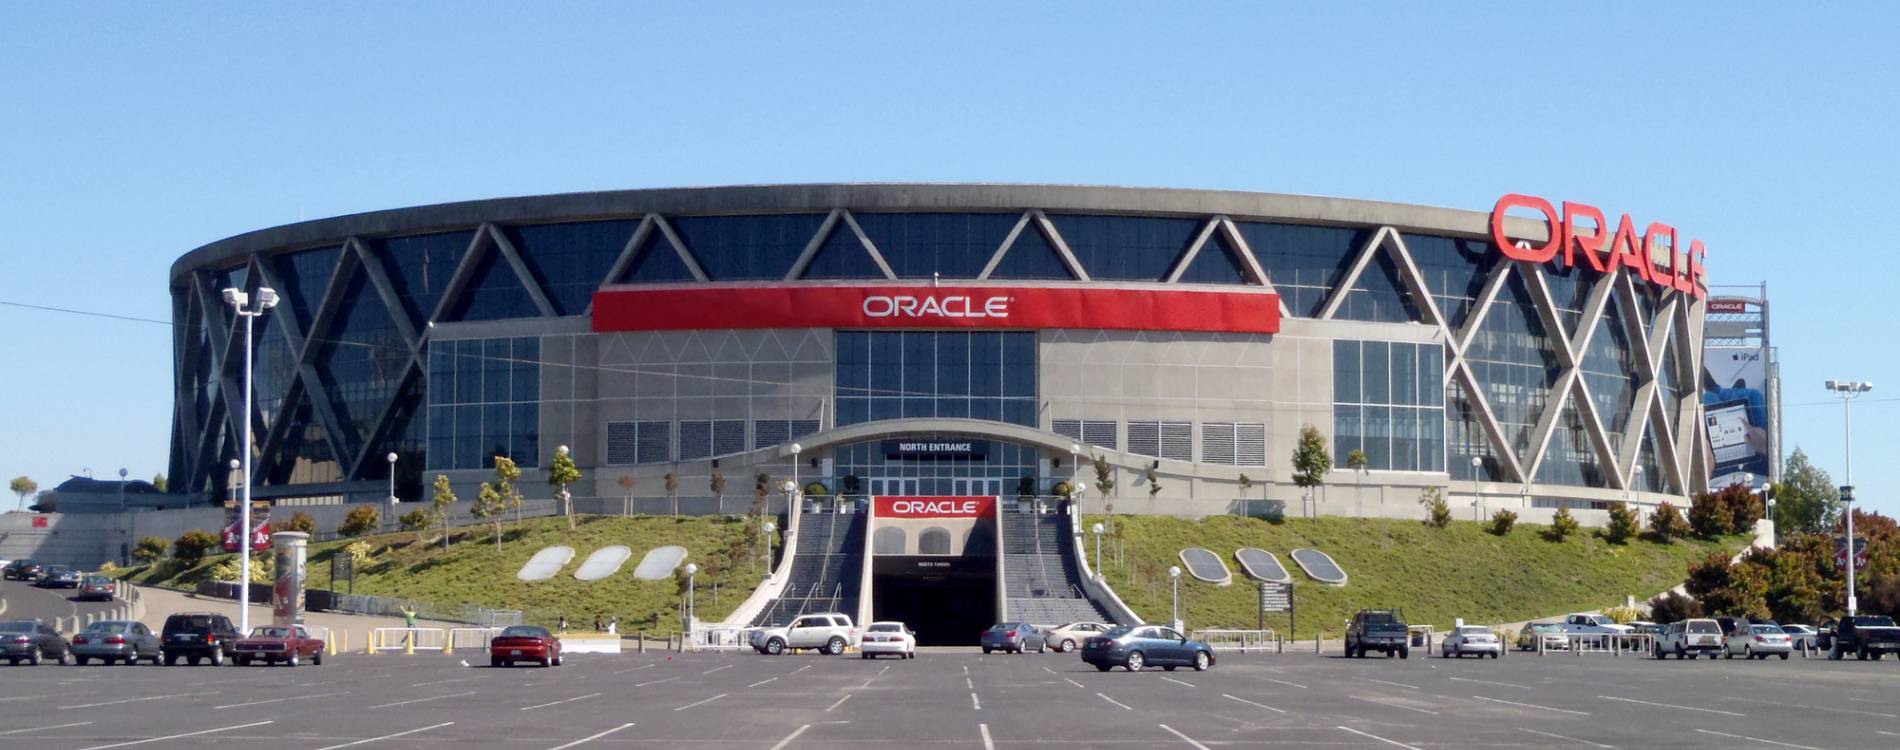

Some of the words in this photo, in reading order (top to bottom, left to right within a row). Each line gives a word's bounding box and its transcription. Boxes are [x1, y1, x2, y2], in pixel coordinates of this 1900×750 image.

[1492, 193, 1708, 301] ORACLE
[863, 295, 1009, 317] ORACLE
[1741, 353, 1759, 361] iPad
[900, 443, 927, 452] NORTH
[929, 443, 971, 452] ENTRANCE
[893, 501, 977, 513] ORACLE
